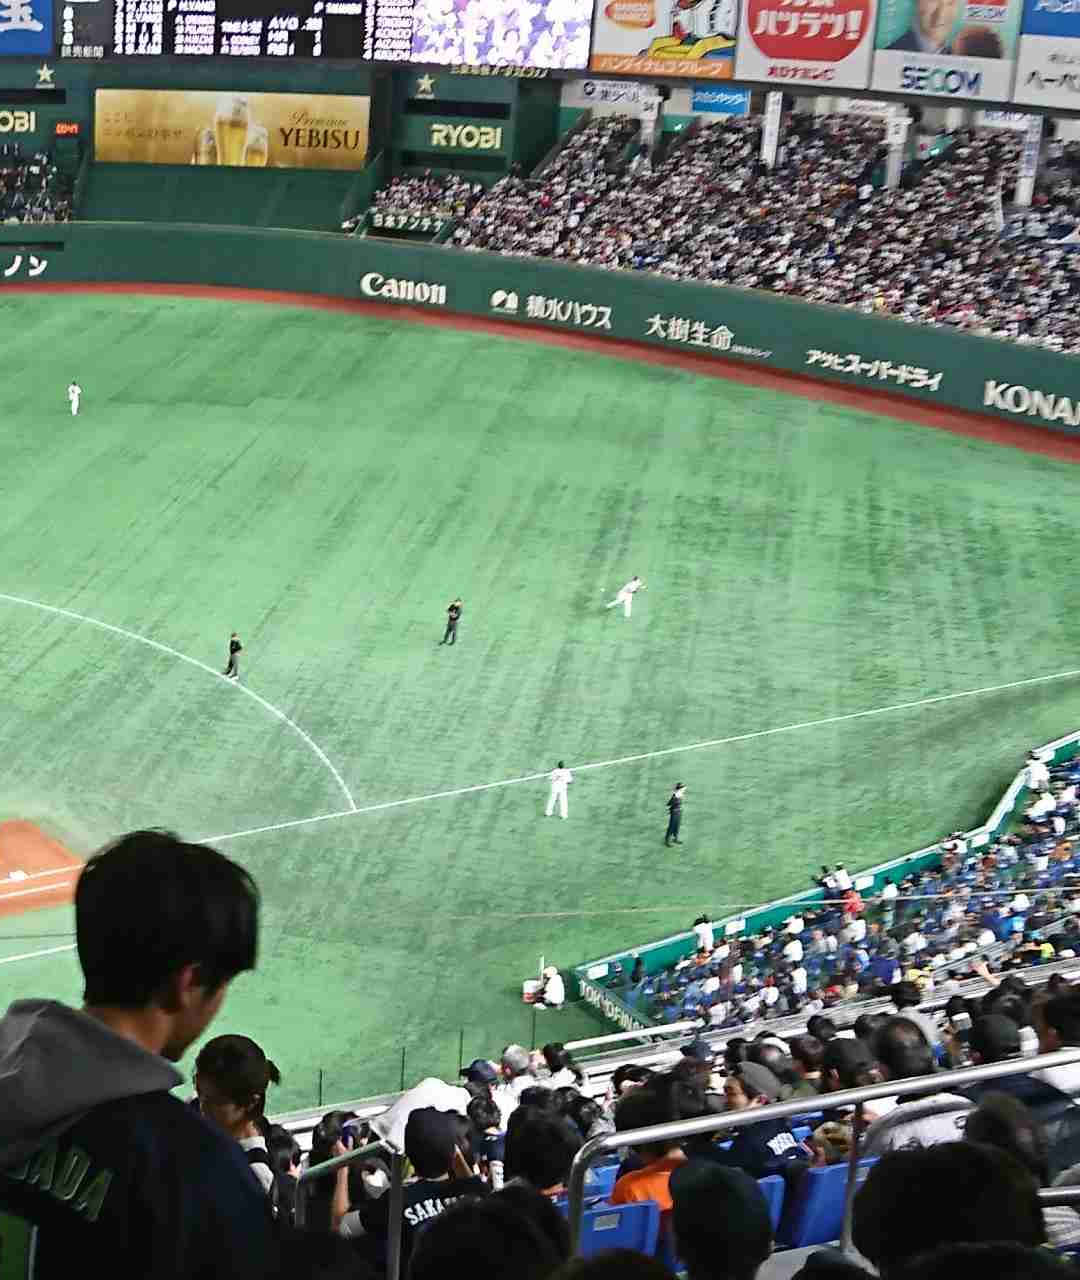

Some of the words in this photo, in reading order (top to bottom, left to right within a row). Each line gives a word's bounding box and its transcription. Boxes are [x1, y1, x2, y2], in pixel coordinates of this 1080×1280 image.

[900, 65, 984, 96] SECOM
[278, 127, 360, 150] YEBISU
[430, 123, 503, 149] RYOBI
[360, 272, 447, 305] Canon
[527, 294, 613, 329] 積水ハウス
[644, 313, 736, 351] 大樹生命
[983, 379, 1080, 426] KONA
